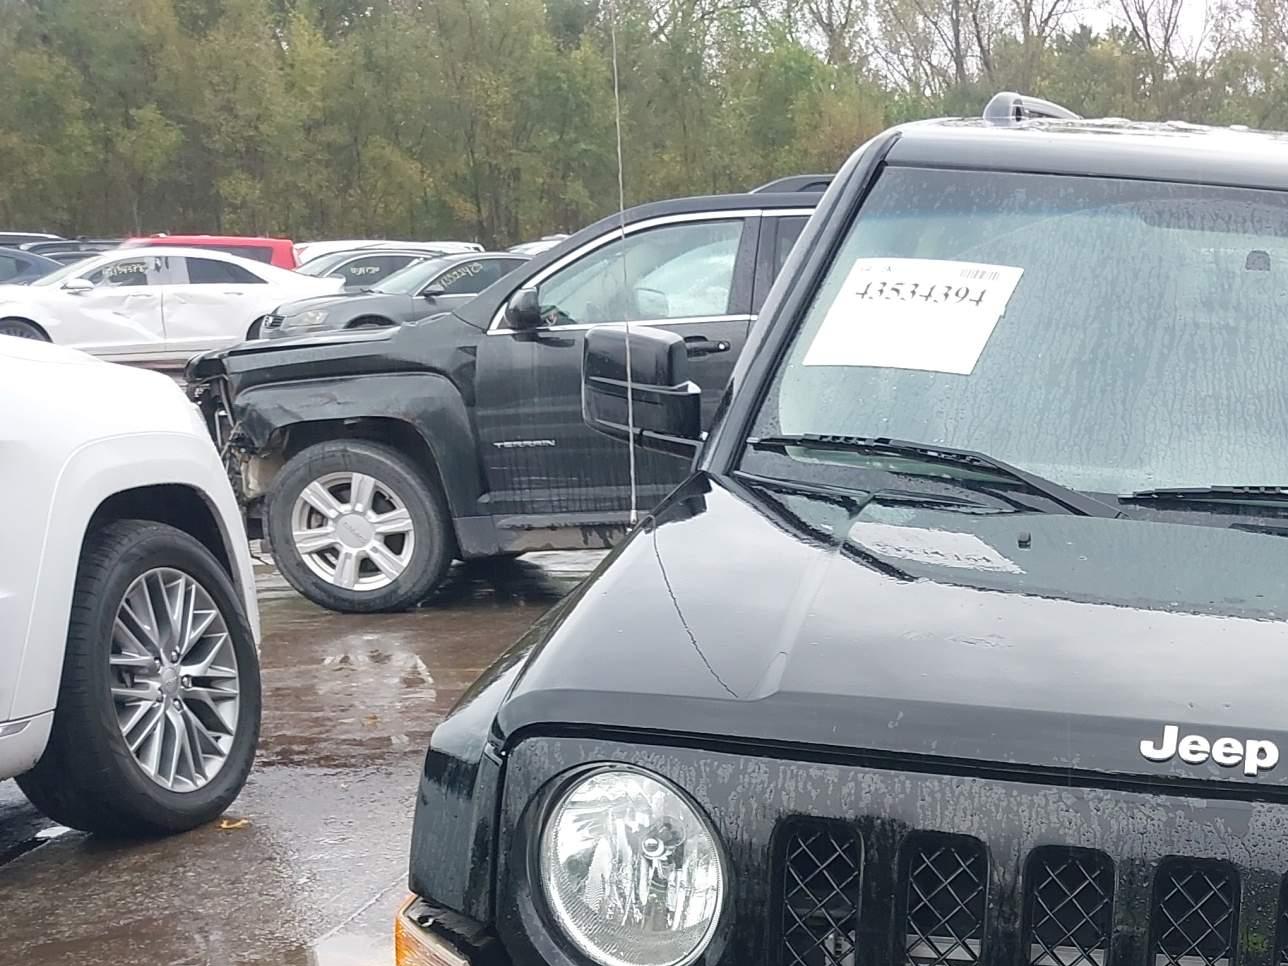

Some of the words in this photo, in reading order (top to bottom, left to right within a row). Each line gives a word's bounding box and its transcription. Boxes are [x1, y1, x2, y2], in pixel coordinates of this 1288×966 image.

[855, 280, 987, 306] 43534394
[493, 439, 556, 449] TERRAIN
[1140, 725, 1280, 777] Jeep
